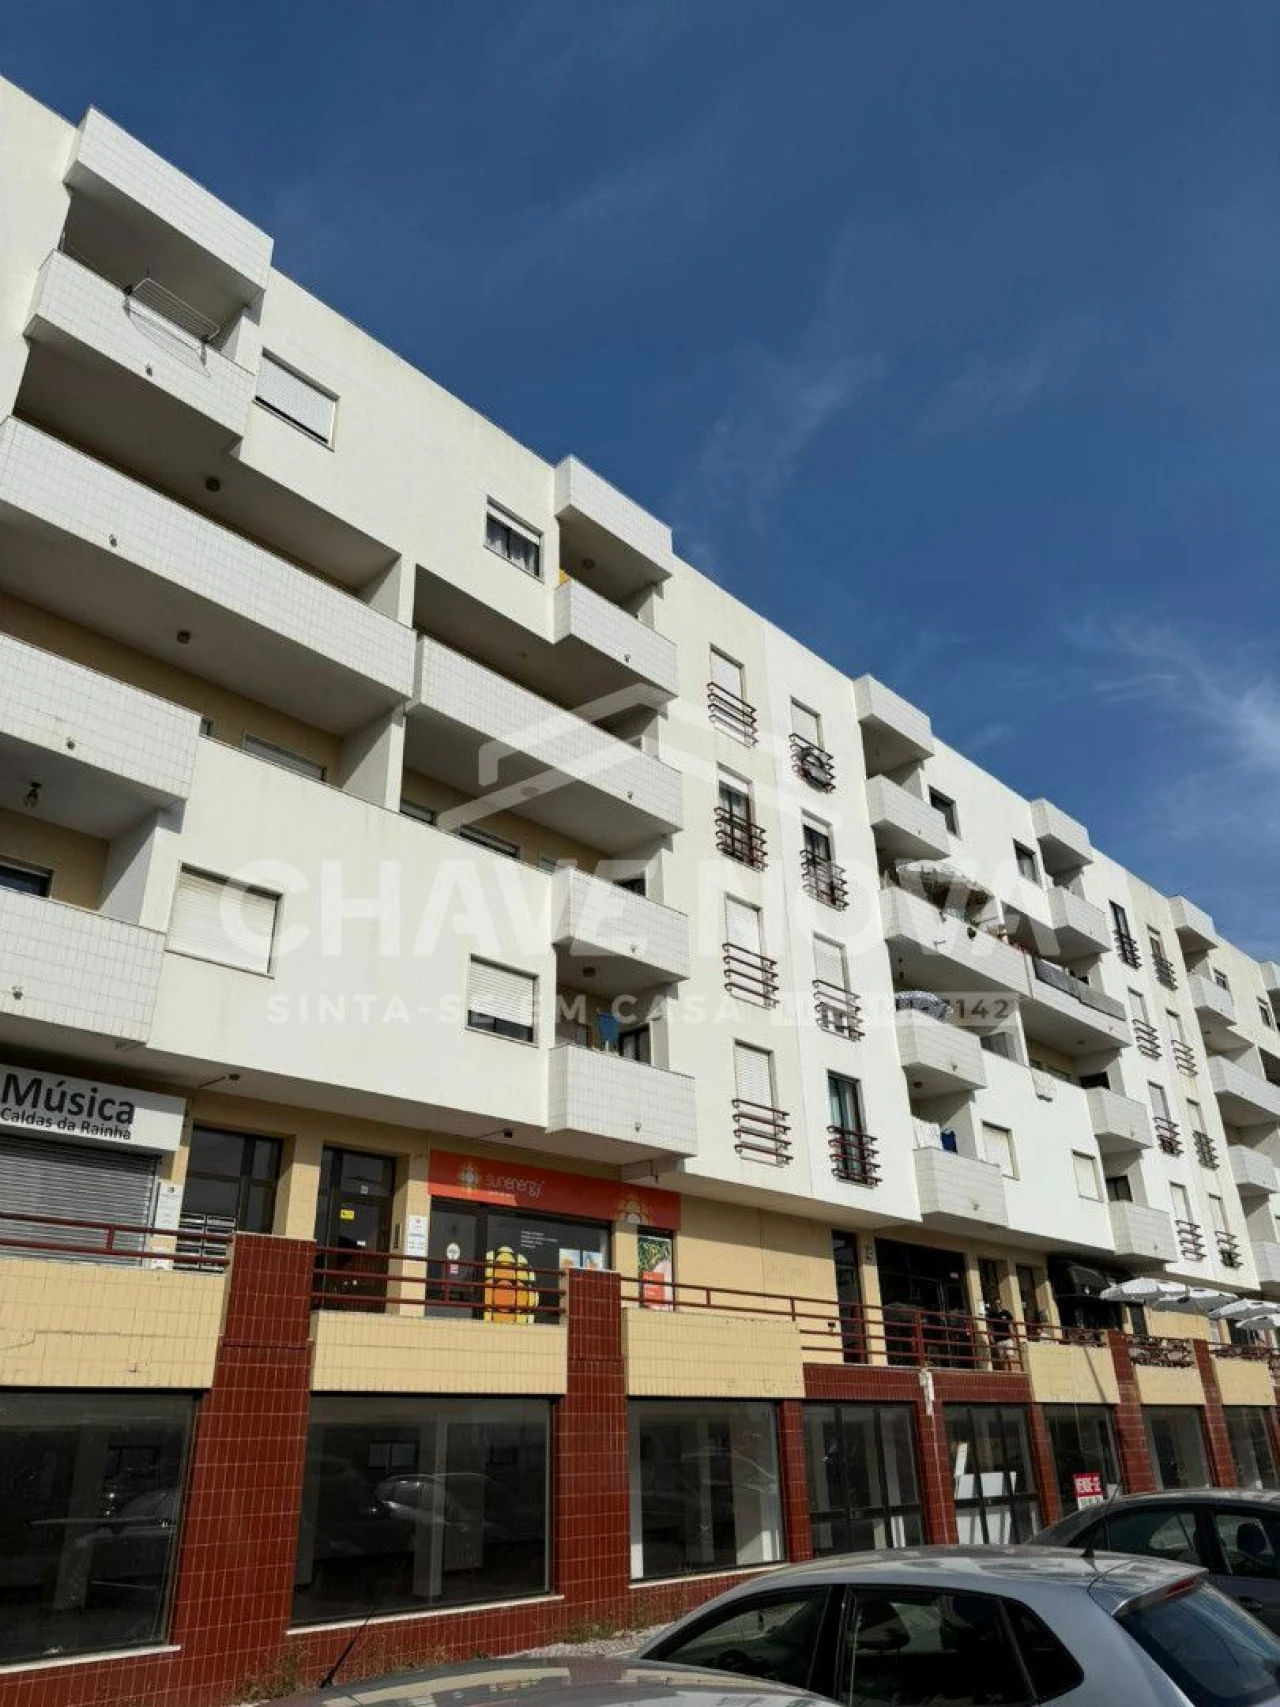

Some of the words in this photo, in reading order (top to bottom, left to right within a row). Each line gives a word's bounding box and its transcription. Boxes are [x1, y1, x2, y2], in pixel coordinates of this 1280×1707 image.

[1, 1072, 135, 1125] Música
[1, 1107, 53, 1128] Caldas
[57, 1117, 77, 1132] da
[80, 1120, 132, 1140] Rainha
